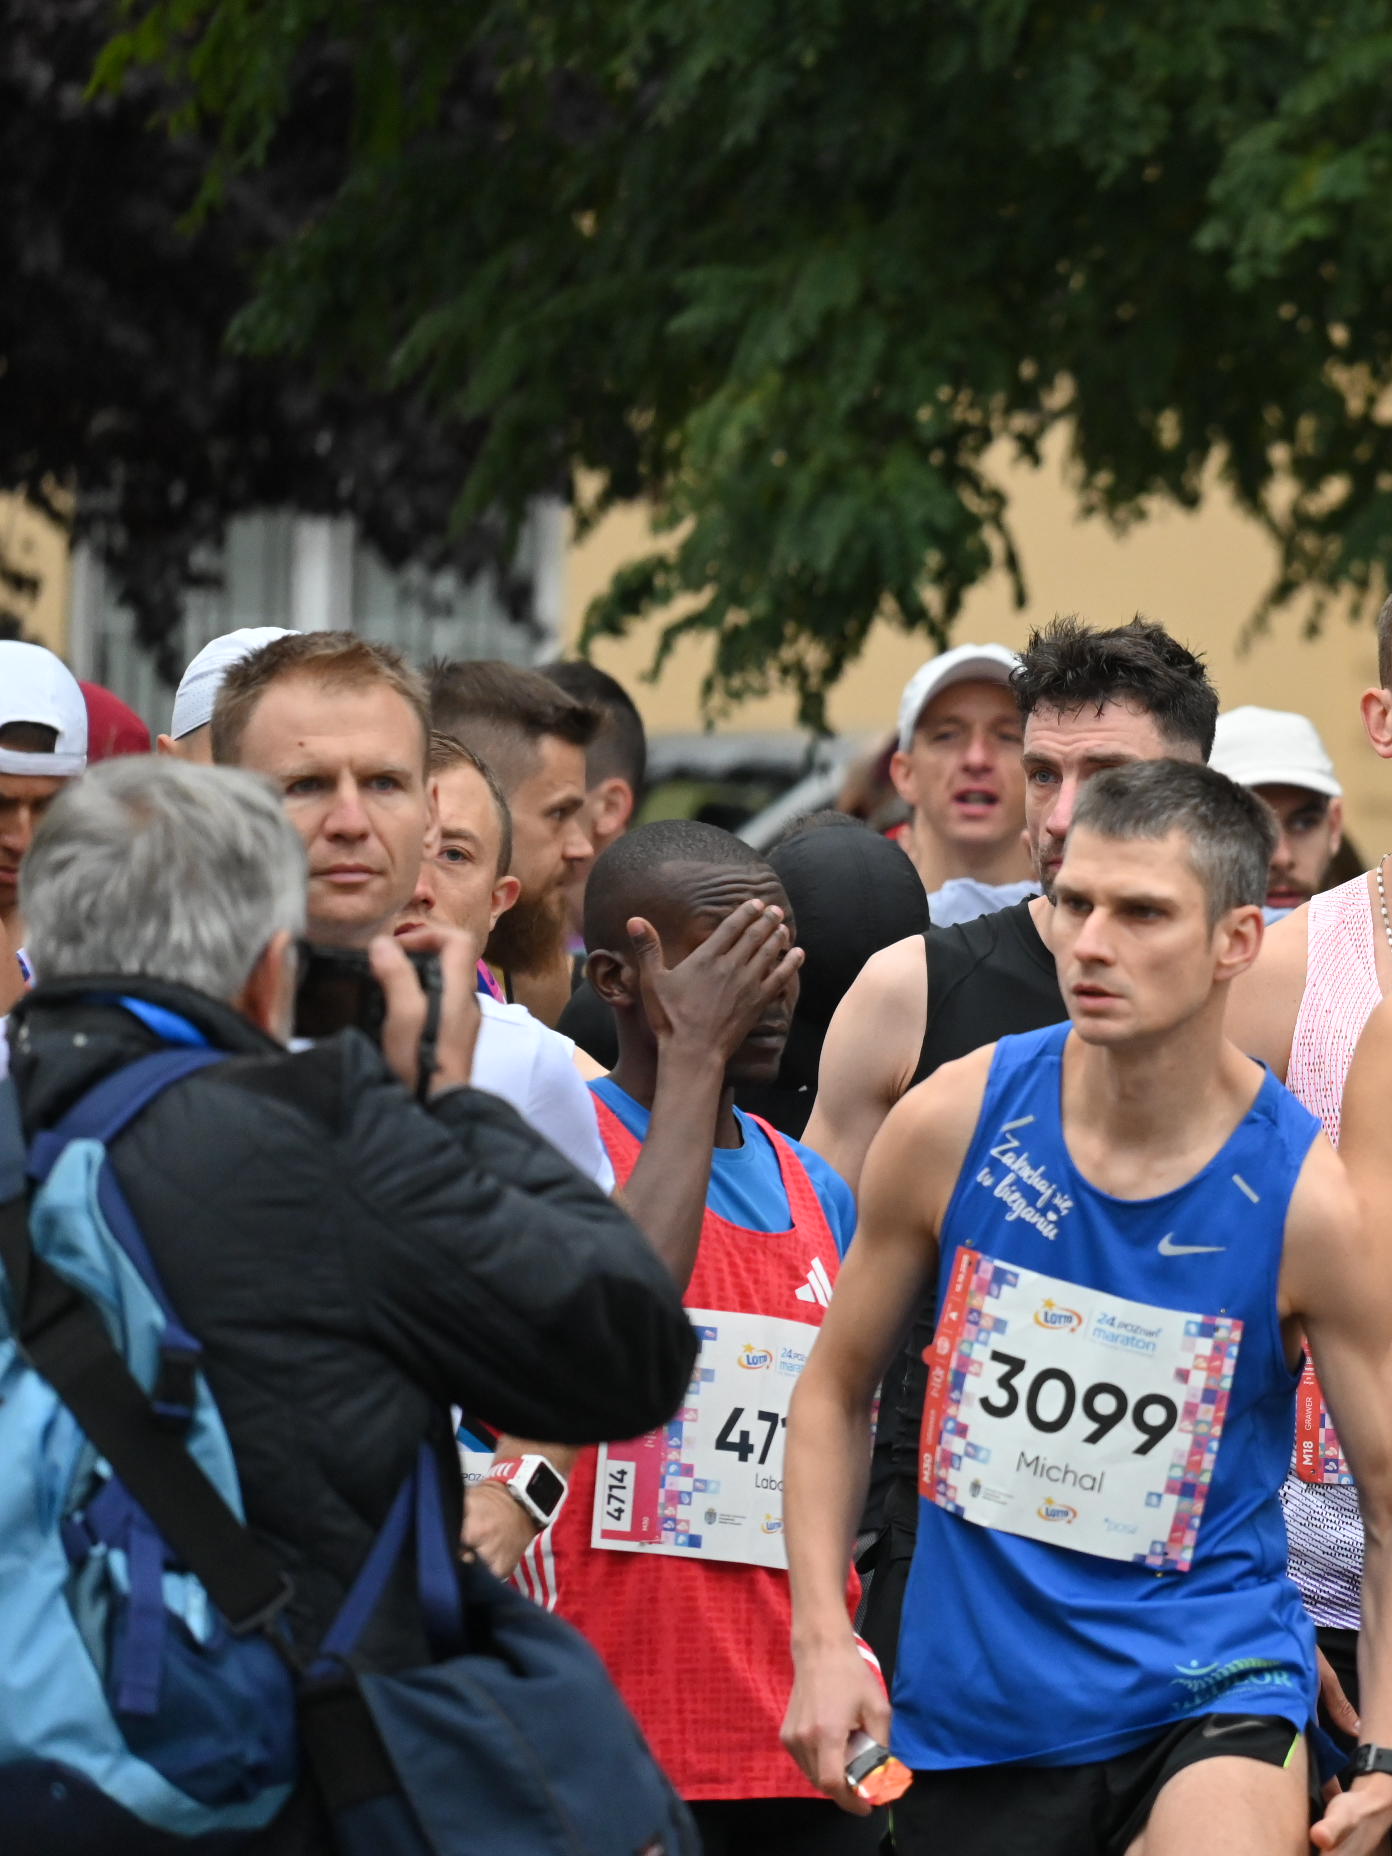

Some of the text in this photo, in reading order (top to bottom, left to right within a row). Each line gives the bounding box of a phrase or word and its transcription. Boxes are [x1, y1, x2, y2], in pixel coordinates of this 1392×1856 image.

[978, 1349, 1179, 1457] 3099
[1304, 1396, 1313, 1431] GRAWER
[1015, 1450, 1106, 1494] Michal
[1302, 1440, 1314, 1466] M18
[606, 1467, 628, 1522] 4714
